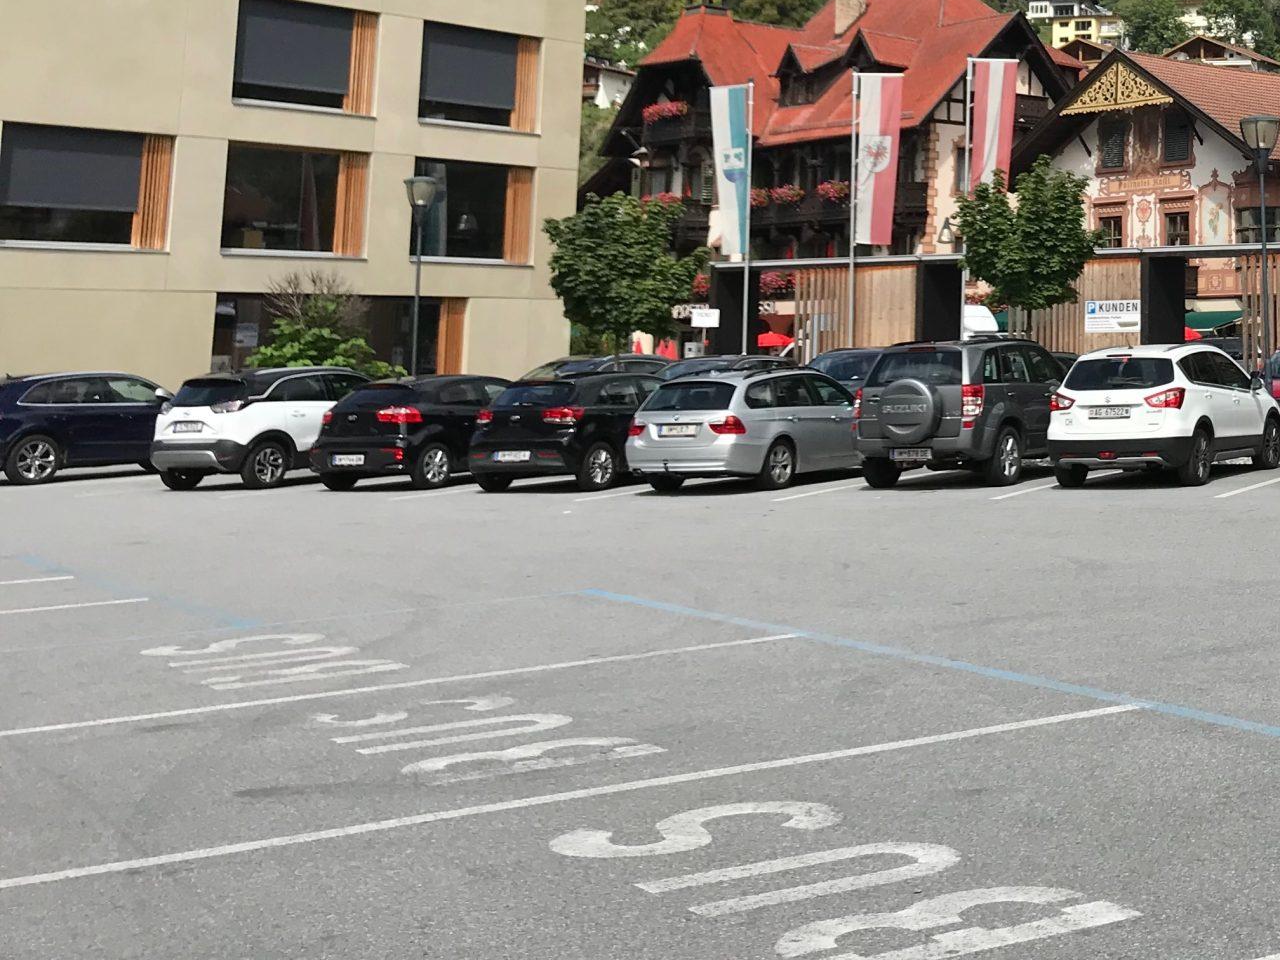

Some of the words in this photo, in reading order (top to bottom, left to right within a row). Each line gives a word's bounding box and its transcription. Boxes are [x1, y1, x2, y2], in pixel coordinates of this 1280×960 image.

[1098, 302, 1138, 312] KUNDEN
[883, 405, 927, 413] SUZUKI
[311, 696, 668, 785] BUS
[548, 801, 1142, 960] BUS
